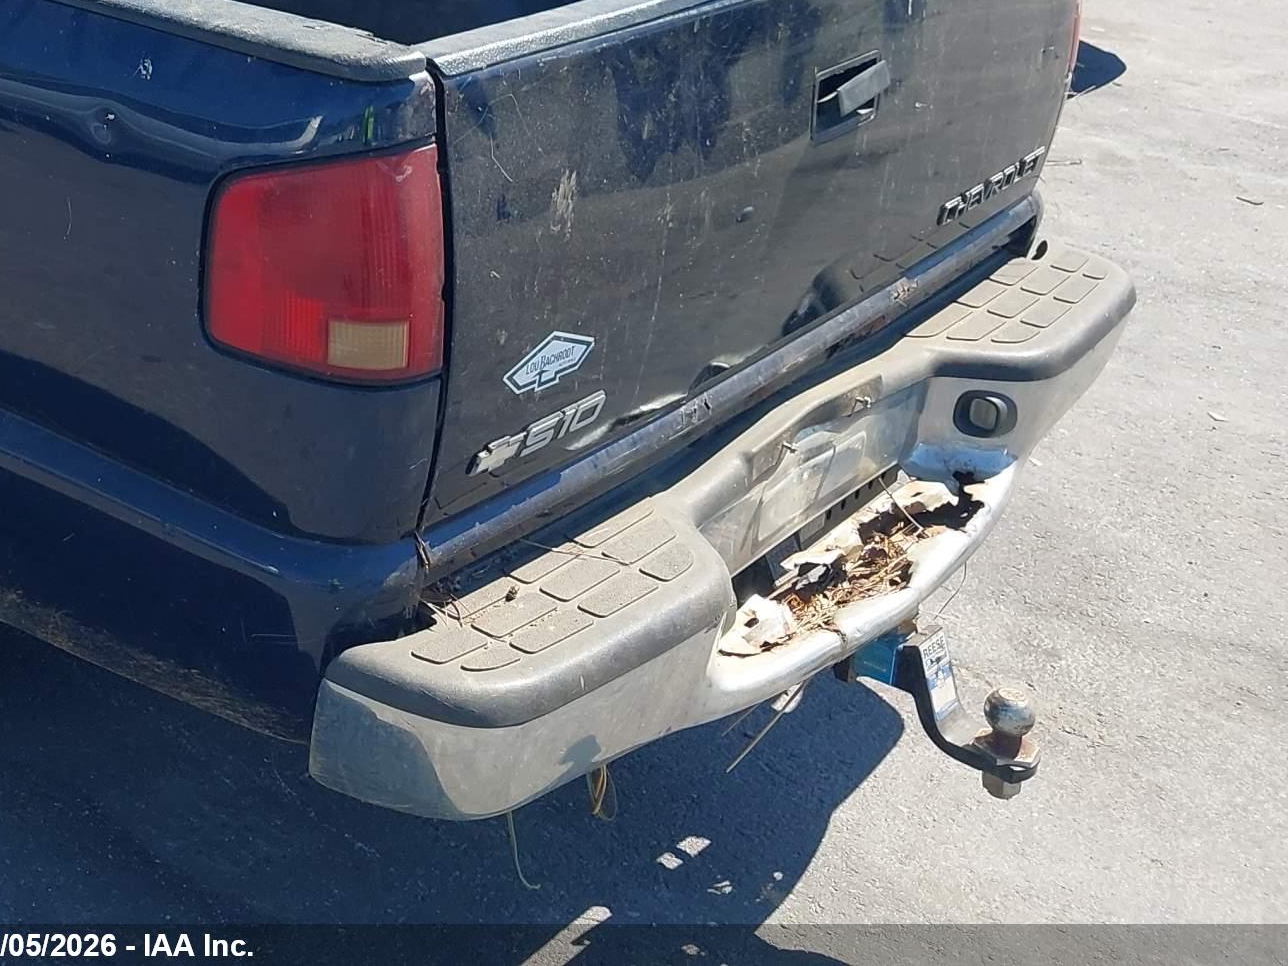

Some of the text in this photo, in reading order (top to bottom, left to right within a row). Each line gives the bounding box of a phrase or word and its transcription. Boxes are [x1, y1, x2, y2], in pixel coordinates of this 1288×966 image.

[936, 144, 1046, 226] CHEVROLET
[525, 358, 541, 375] LOU
[519, 388, 607, 458] S10
[922, 636, 945, 659] REESE
